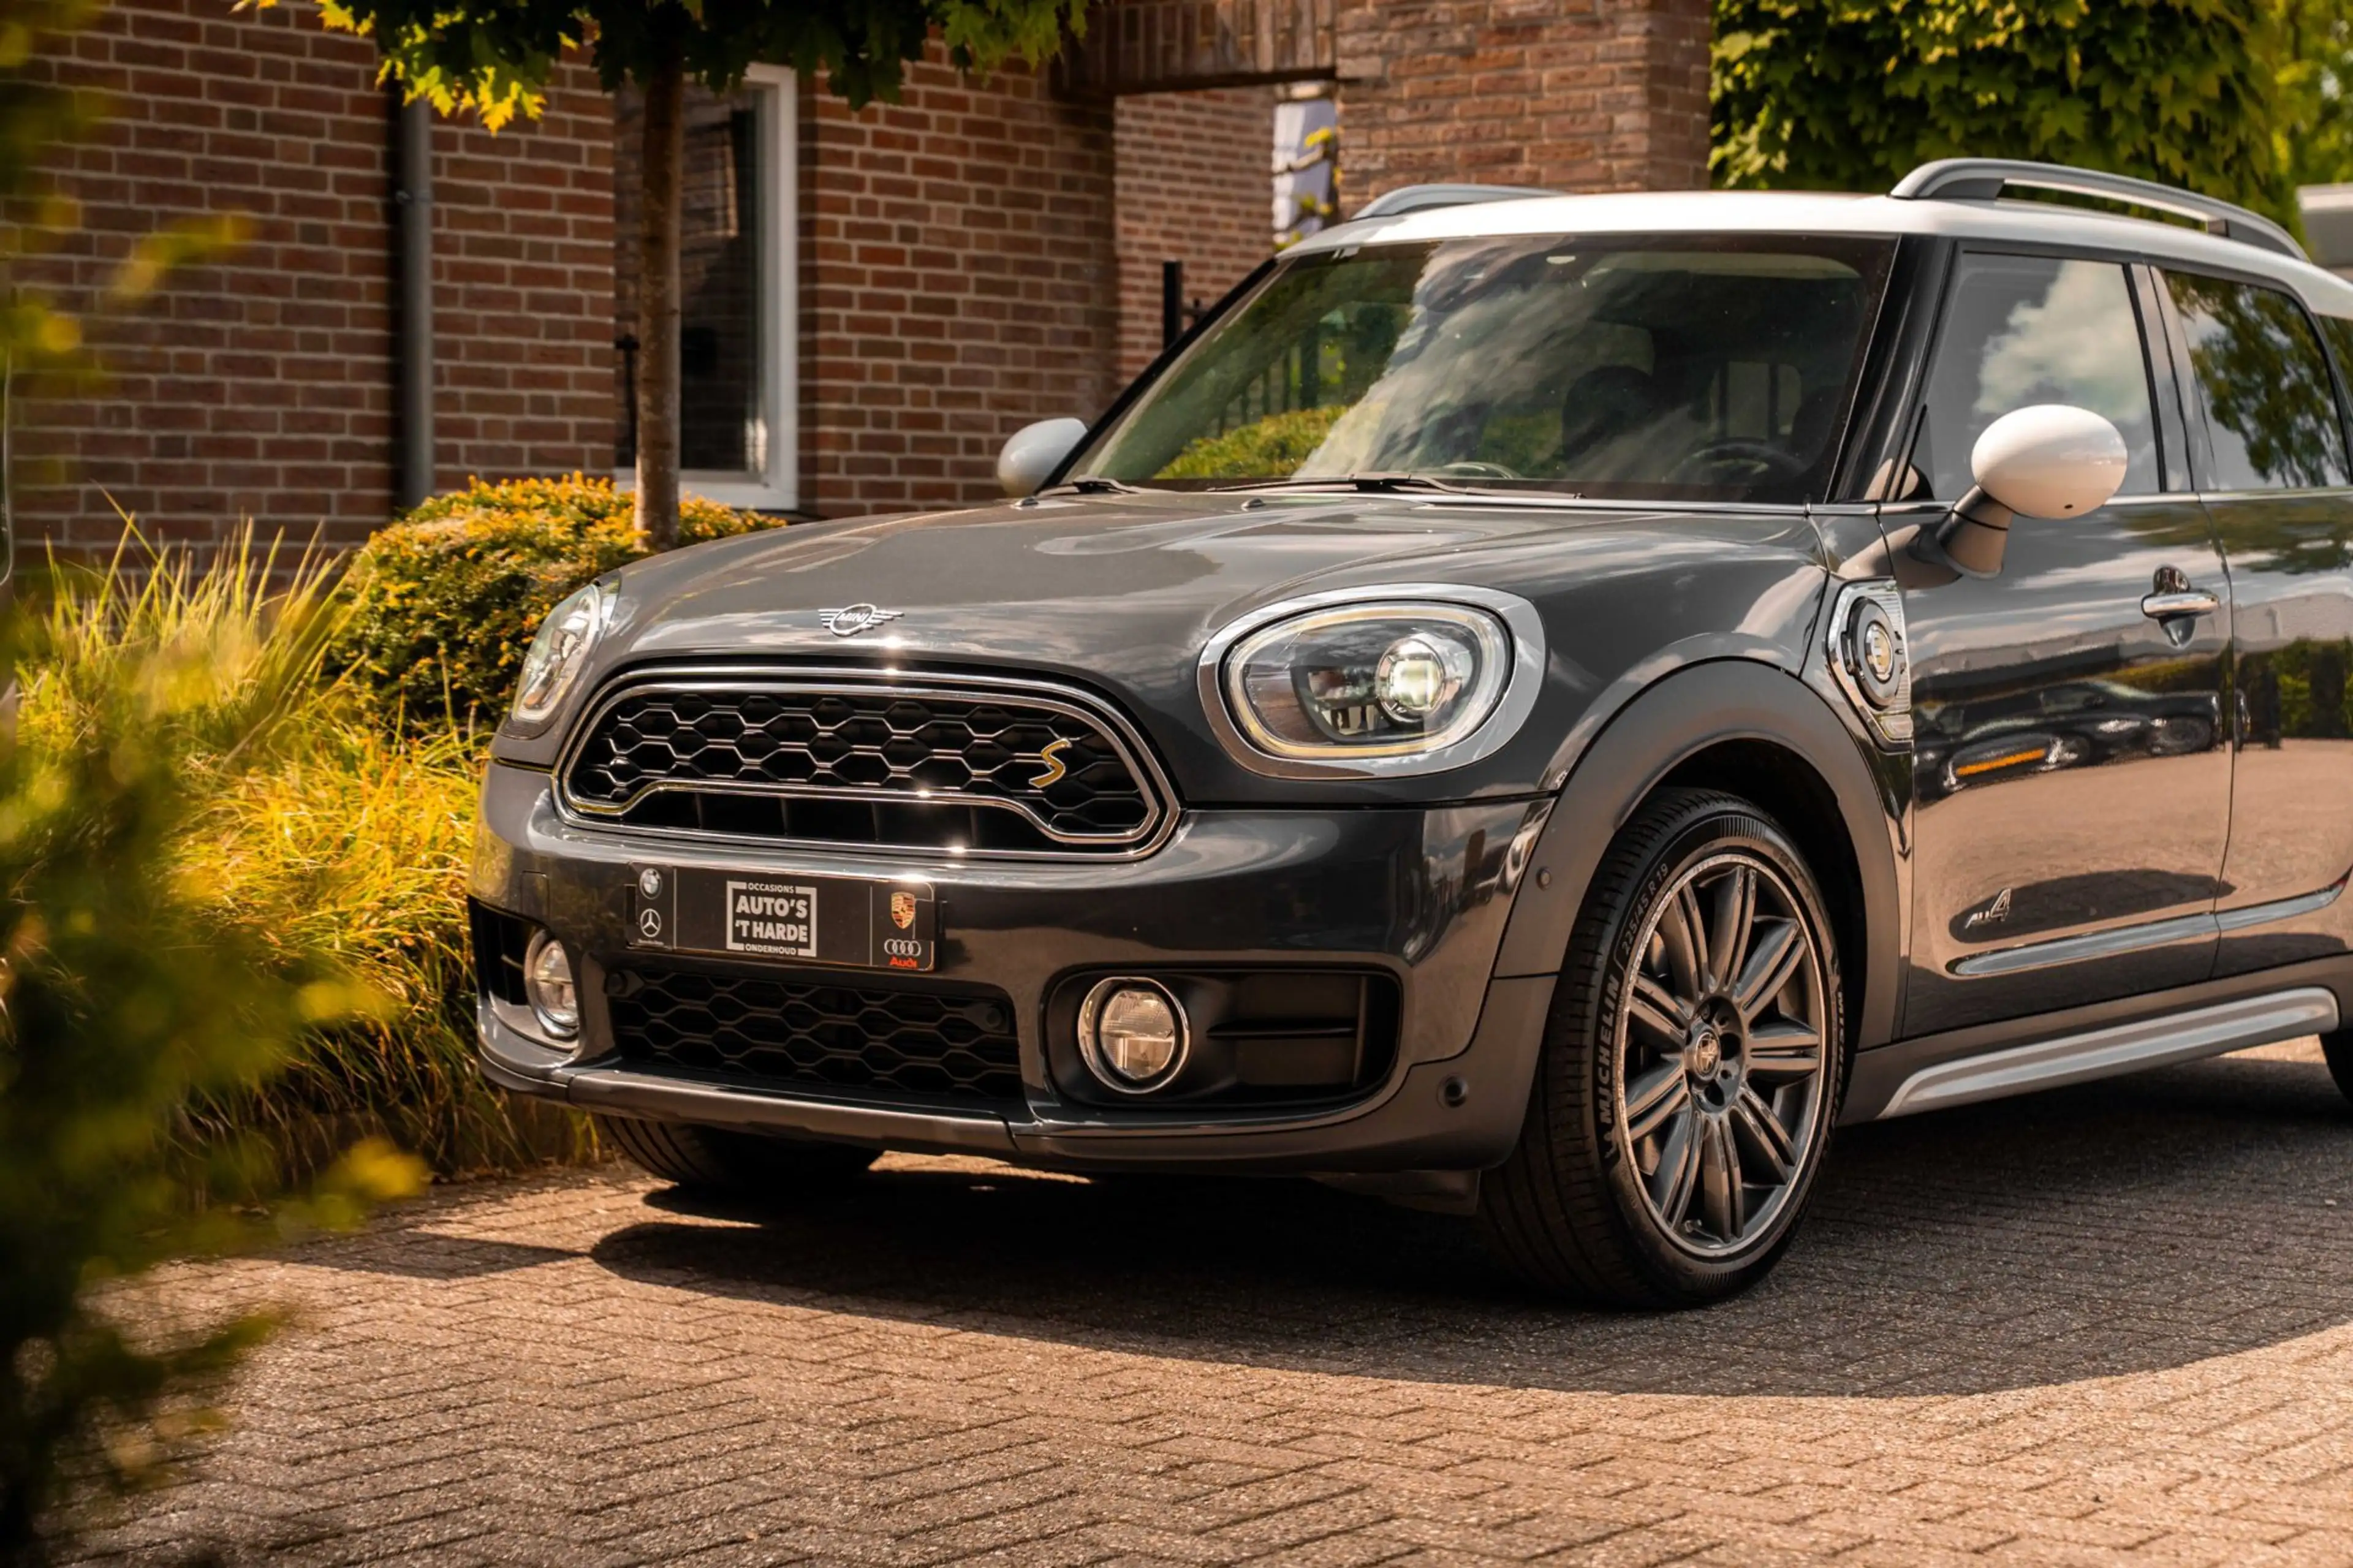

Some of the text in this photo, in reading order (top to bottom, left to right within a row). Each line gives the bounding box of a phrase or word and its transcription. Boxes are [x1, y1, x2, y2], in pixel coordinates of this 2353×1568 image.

[1656, 863, 1669, 881] 19
[748, 882, 794, 893] OCCASIONS
[736, 895, 808, 918] AUTO'S
[735, 920, 808, 942] 'T HARDE
[745, 944, 797, 955] ONDERHOUD
[890, 956, 917, 968] Audi
[1597, 974, 1621, 1124] MICHELIN
